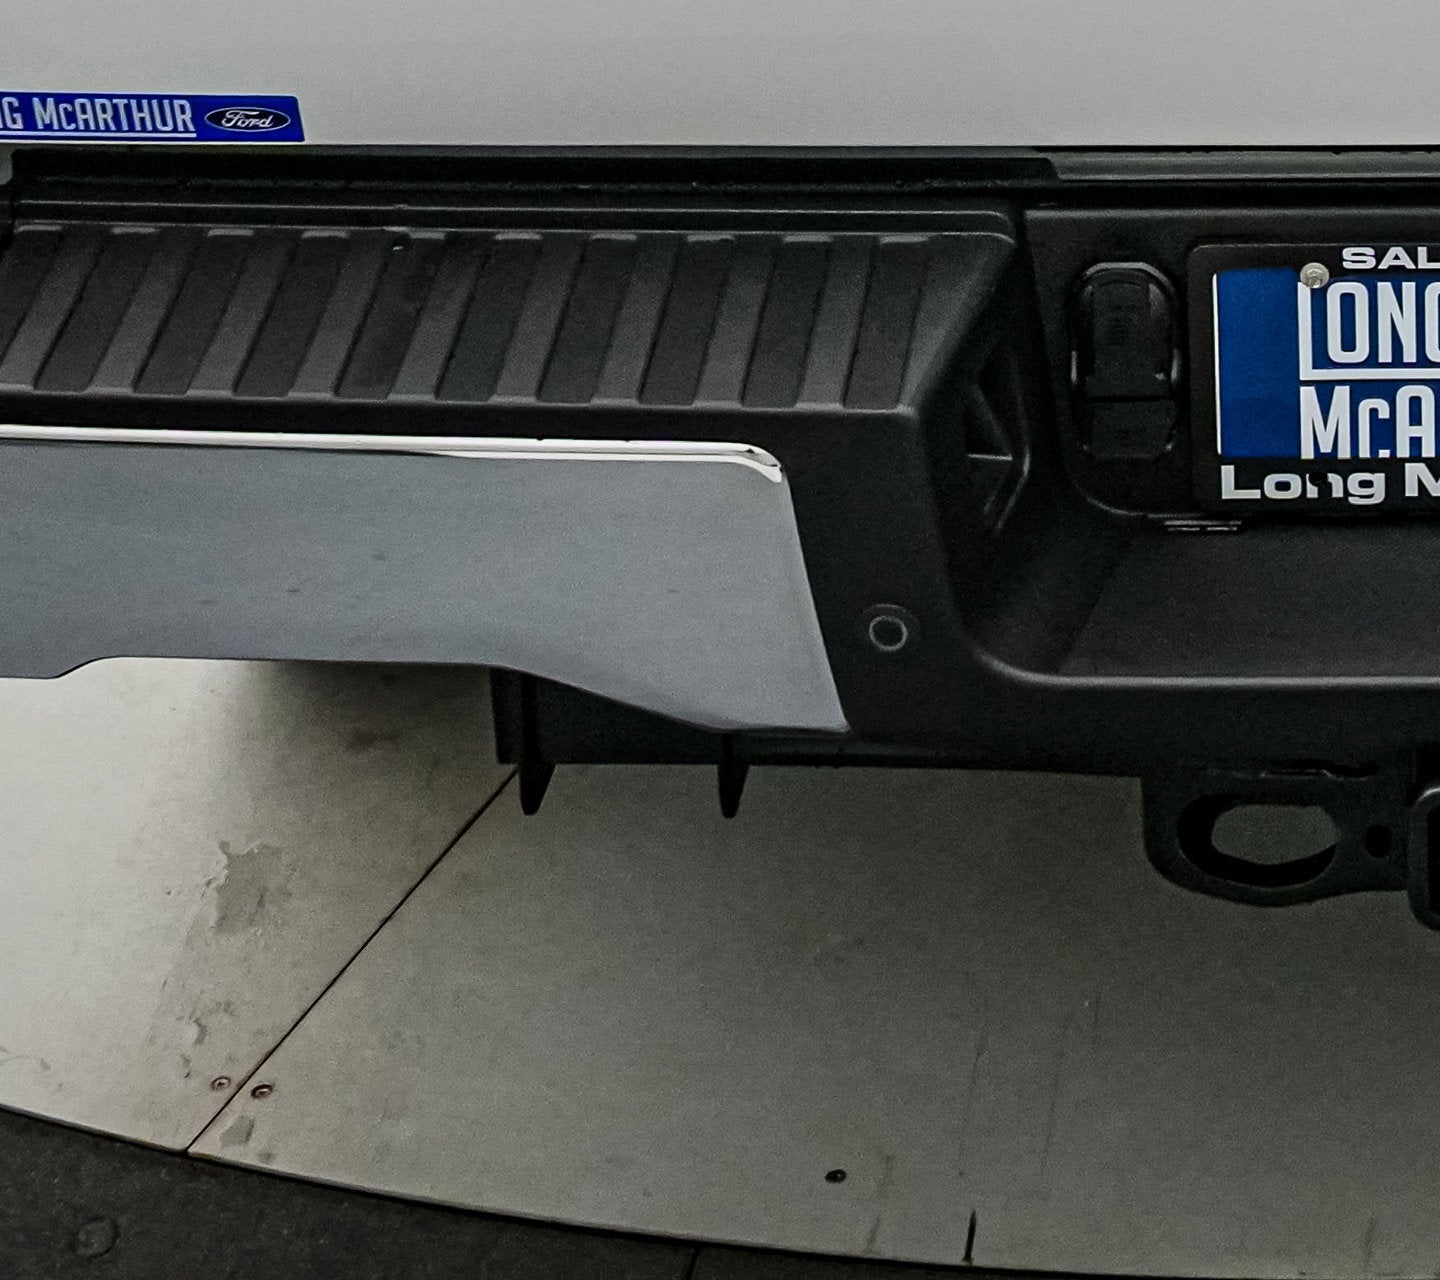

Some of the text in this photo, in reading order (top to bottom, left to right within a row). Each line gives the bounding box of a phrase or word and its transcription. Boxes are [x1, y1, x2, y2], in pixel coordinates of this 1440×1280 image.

[33, 97, 196, 132] McARTHUR
[221, 110, 274, 128] Ford
[1220, 463, 1386, 505] Long
